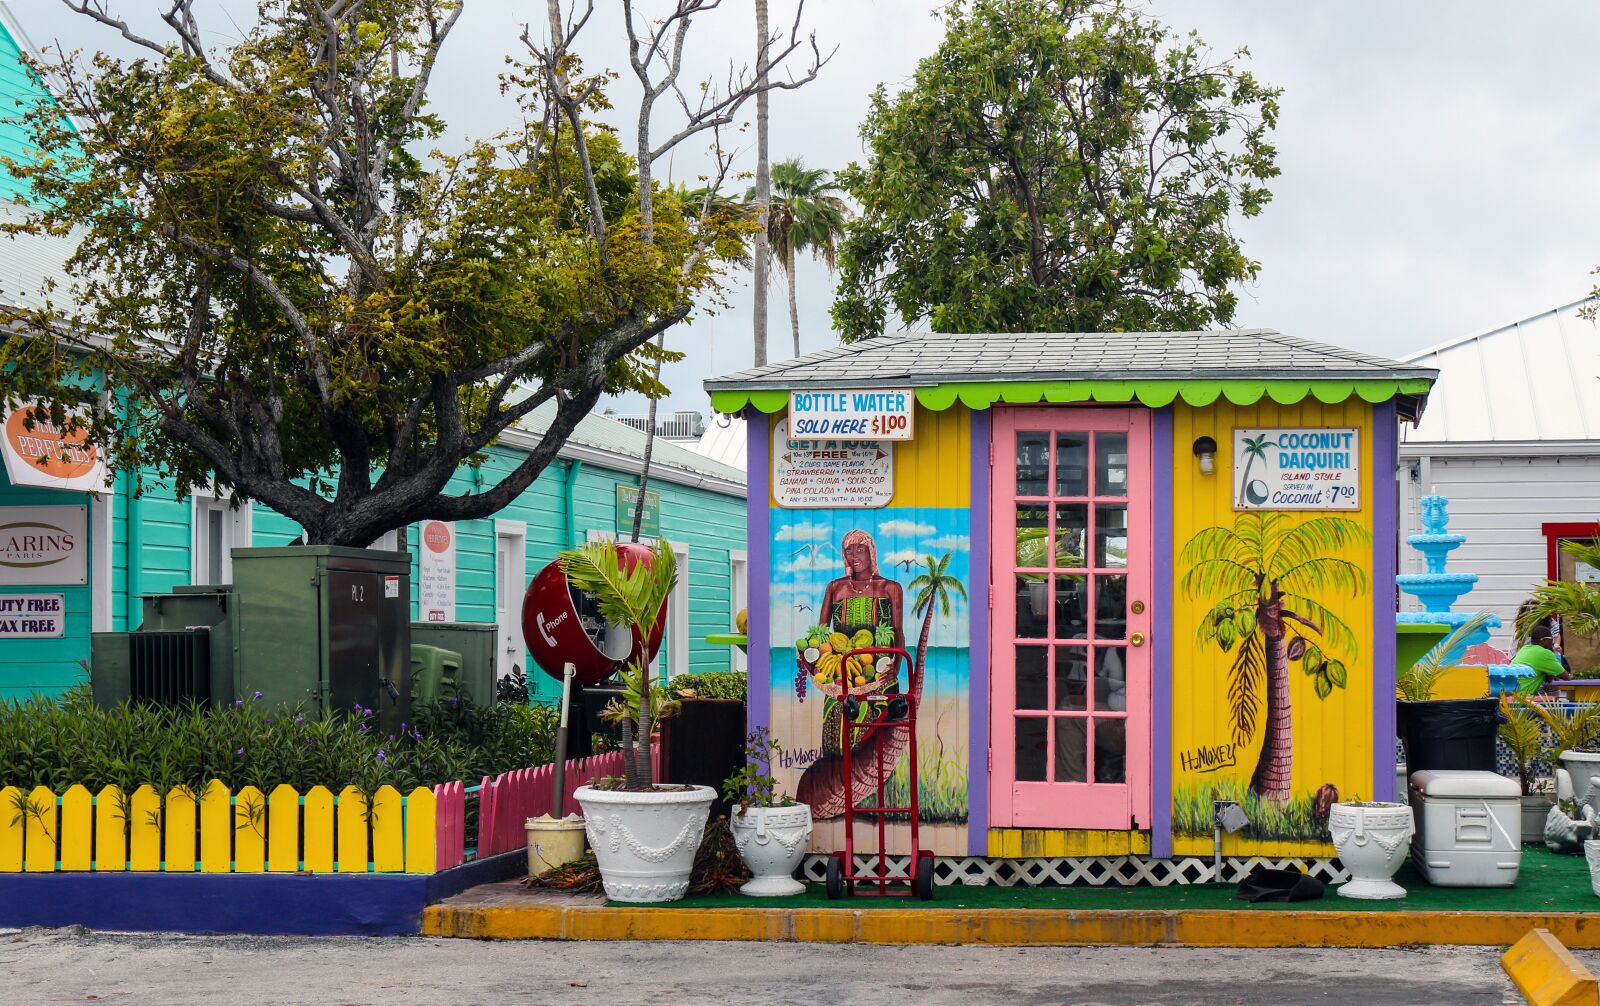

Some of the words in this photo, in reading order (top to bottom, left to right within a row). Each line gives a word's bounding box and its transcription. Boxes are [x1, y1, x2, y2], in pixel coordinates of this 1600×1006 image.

[794, 394, 847, 412] BOTTLE
[853, 394, 905, 412] WATER
[796, 419, 829, 434] SOLD
[831, 419, 868, 434] HERE
[872, 415, 907, 434] $1.00
[786, 440, 818, 450] GET
[1278, 433, 1353, 449] COCONUT
[1279, 452, 1349, 470] DAIQUIRI
[1272, 490, 1322, 504] Coconut
[28, 599, 60, 612] FREE
[0, 620, 18, 632] AX
[21, 620, 55, 632] FREE
[545, 612, 568, 632] Phone
